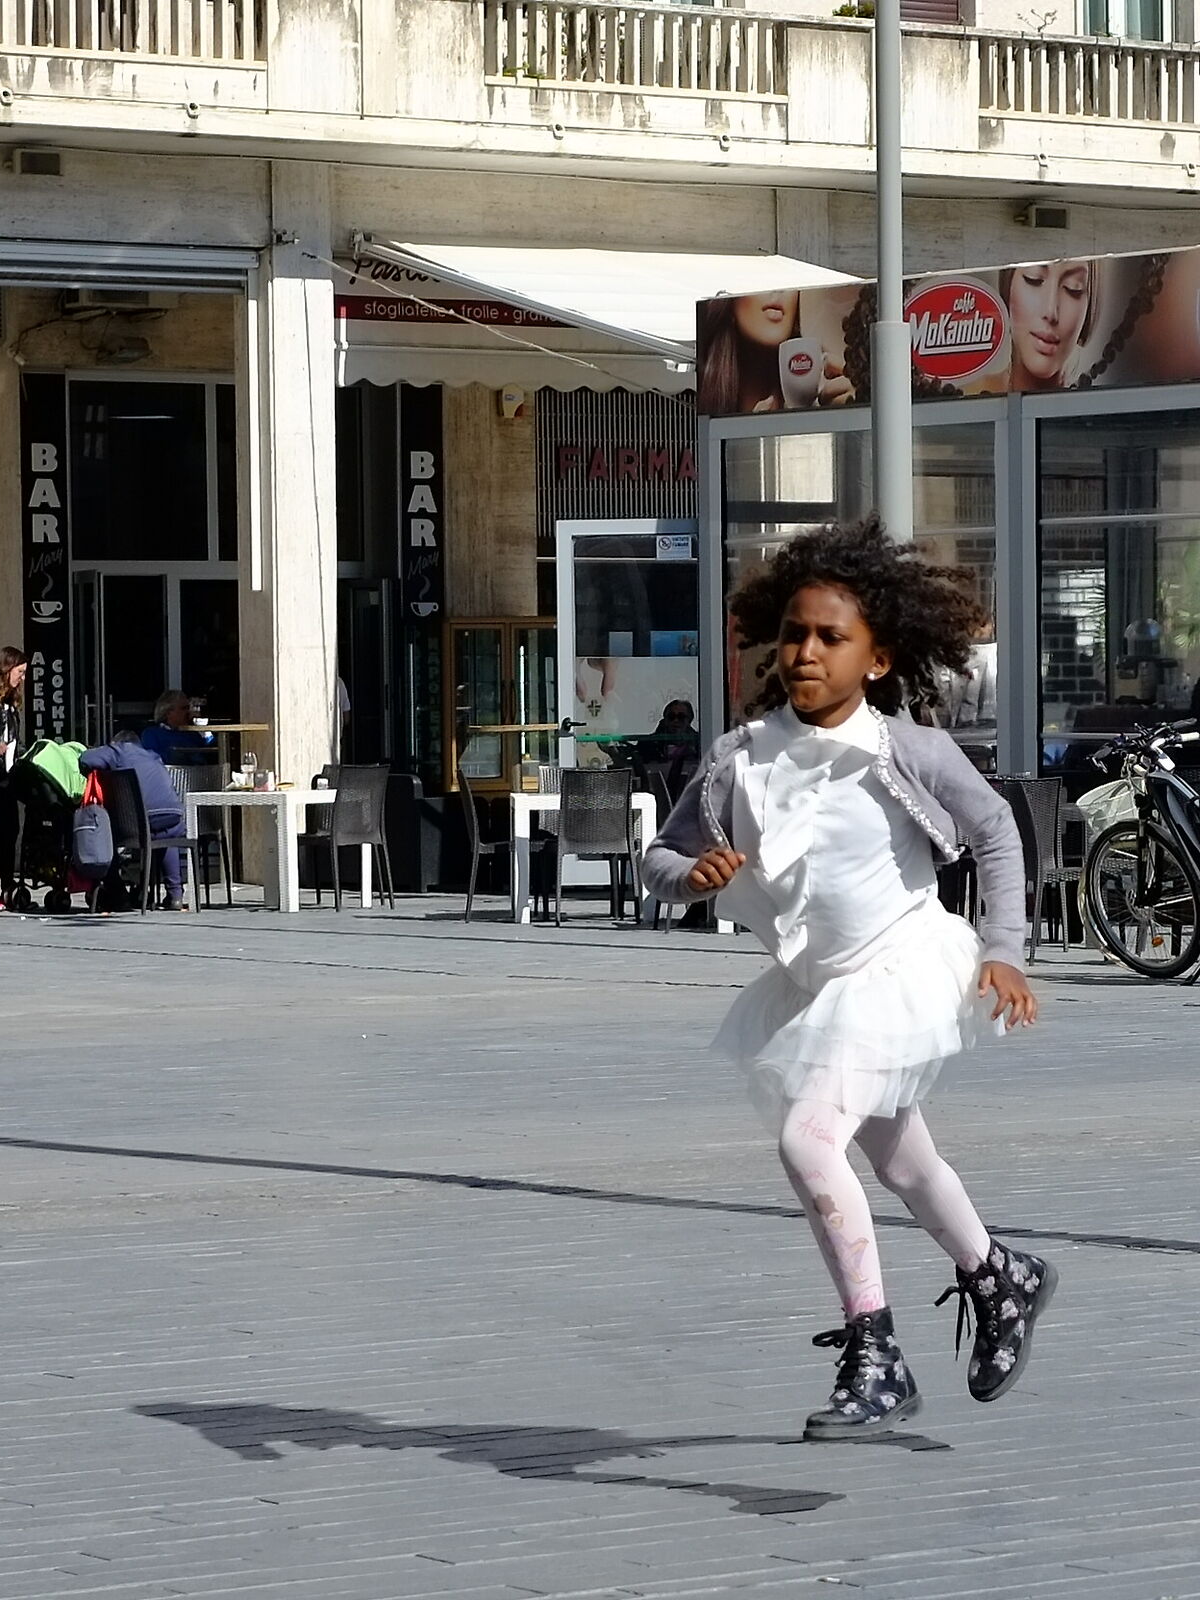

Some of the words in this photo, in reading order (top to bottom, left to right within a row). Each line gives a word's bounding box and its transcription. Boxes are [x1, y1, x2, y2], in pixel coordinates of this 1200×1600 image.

[461, 304, 500, 319] frolle
[28, 442, 62, 543] BAR
[559, 447, 698, 481] FARMA
[407, 450, 438, 547] BAR
